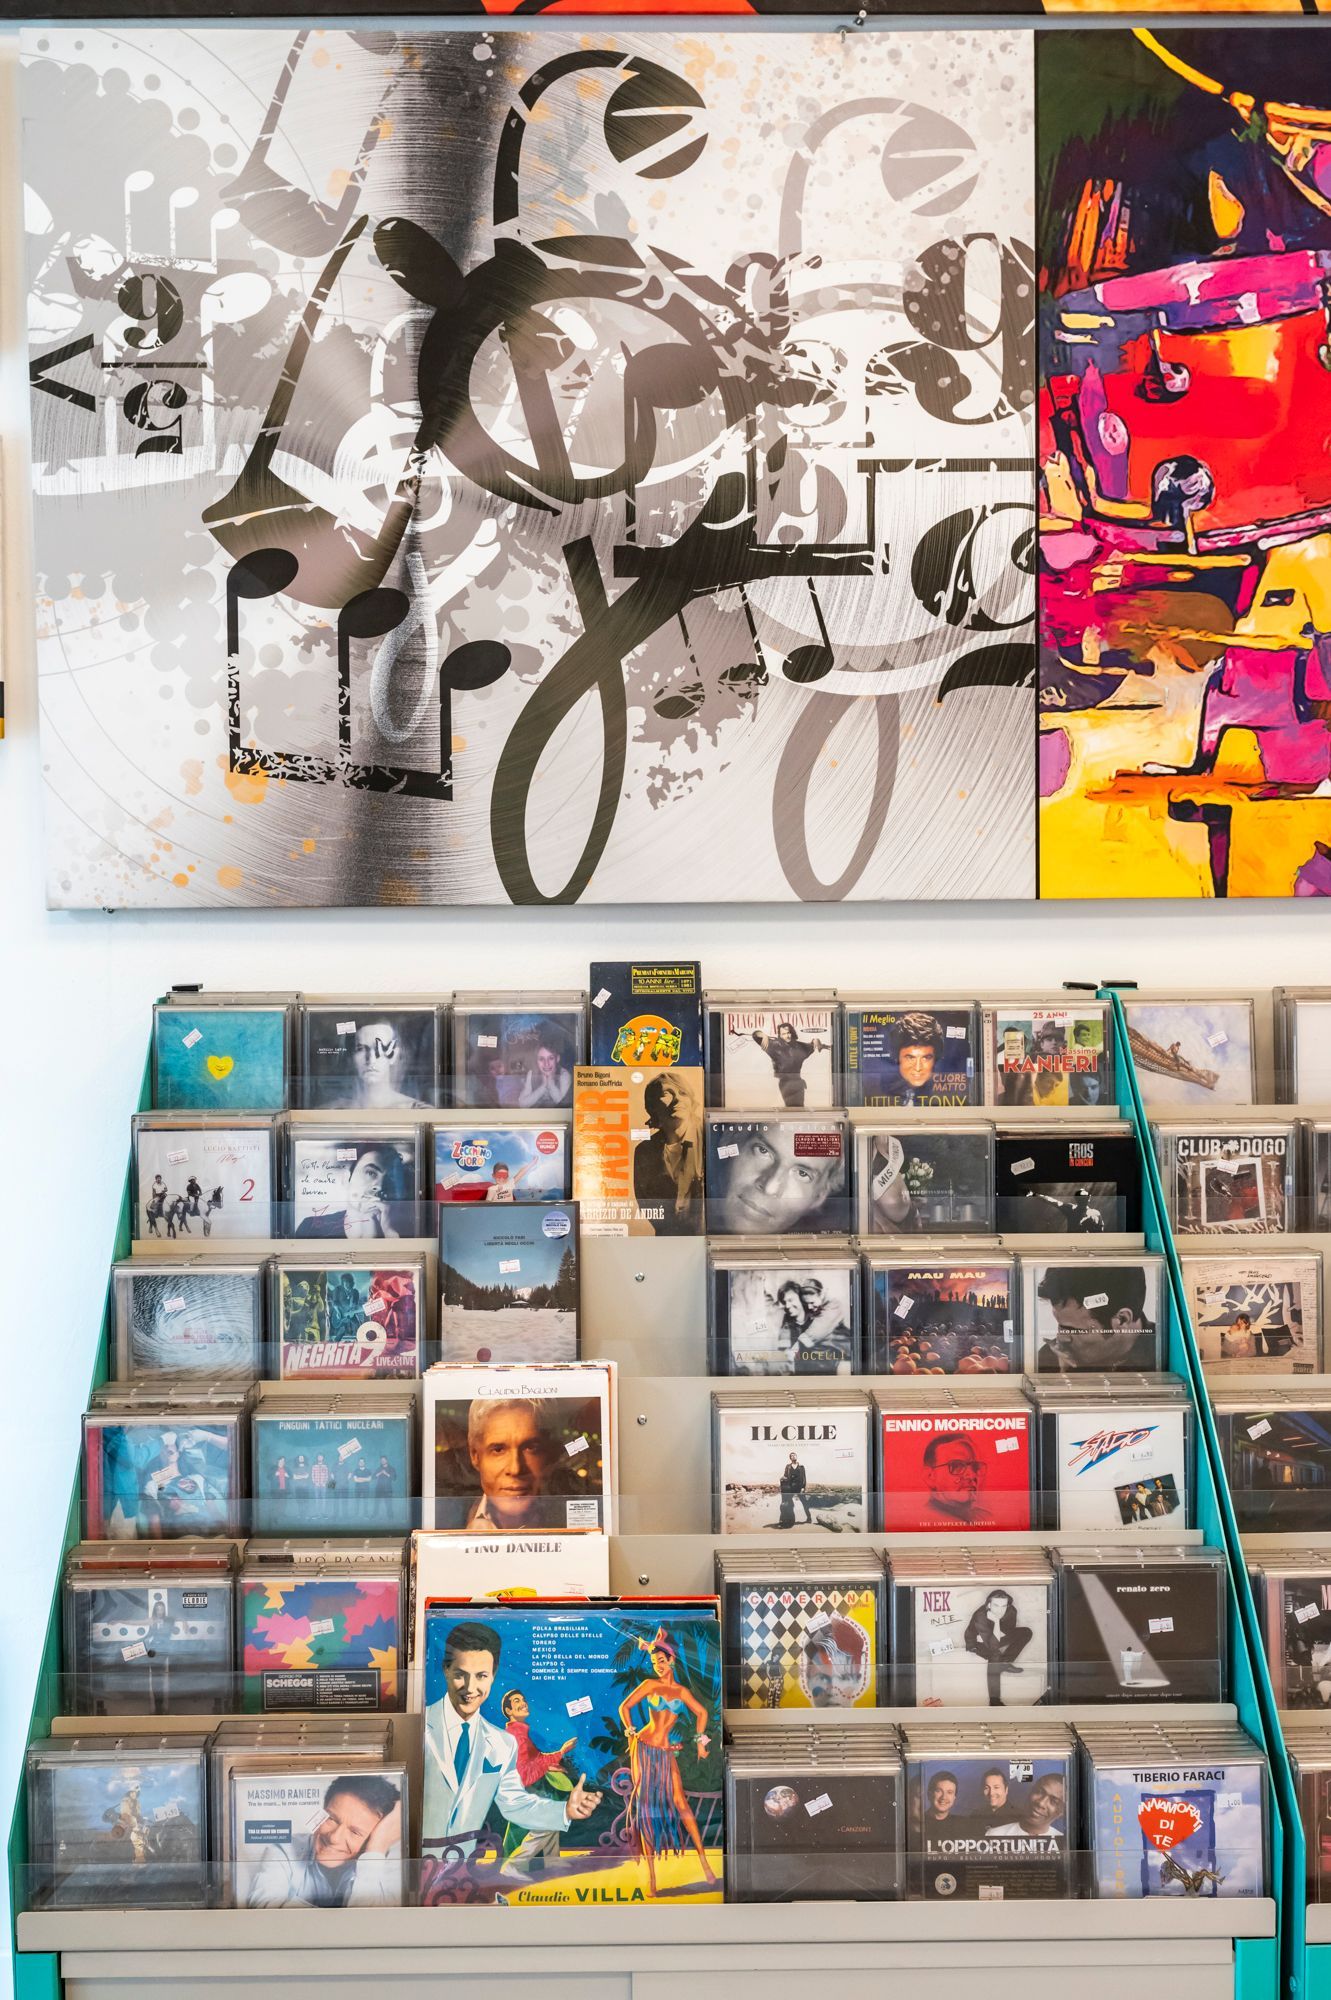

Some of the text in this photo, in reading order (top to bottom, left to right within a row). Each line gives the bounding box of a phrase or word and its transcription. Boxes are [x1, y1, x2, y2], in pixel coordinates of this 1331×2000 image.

[728, 1013, 765, 1035] BIAGIO
[869, 1014, 896, 1025] Meglio
[577, 1071, 611, 1080] Bruno Bigoni
[933, 1073, 966, 1082] CUORE
[599, 1079, 623, 1087] Giuffrida
[932, 1083, 966, 1091] MATTO
[917, 1096, 967, 1107] TONY
[1069, 1143, 1094, 1159] EROS
[1177, 1138, 1286, 1157] CLUB DOGO
[240, 1178, 255, 1202] 2
[580, 1205, 665, 1220] ABRIZIO DE ANDRÉ
[885, 1418, 1026, 1432] ENNIO MORRICONE
[750, 1425, 837, 1441] IL CILE
[506, 1541, 562, 1553] DANIELE
[1116, 1585, 1147, 1593] renato
[750, 1593, 870, 1605] CAMERINI
[923, 1591, 951, 1612] NEK
[266, 1678, 314, 1688] SCHEGGE
[1133, 1770, 1225, 1783] TIBERIO FARACI
[247, 1788, 320, 1800] MASSIMO RANIERI
[1138, 1798, 1203, 1833] INNAMORATI
[1159, 1819, 1175, 1831] DI
[927, 1835, 1061, 1855] L'OPPORTUNITÀ
[1152, 1834, 1173, 1848] TE
[517, 1888, 645, 1903] Claudio VILLA
